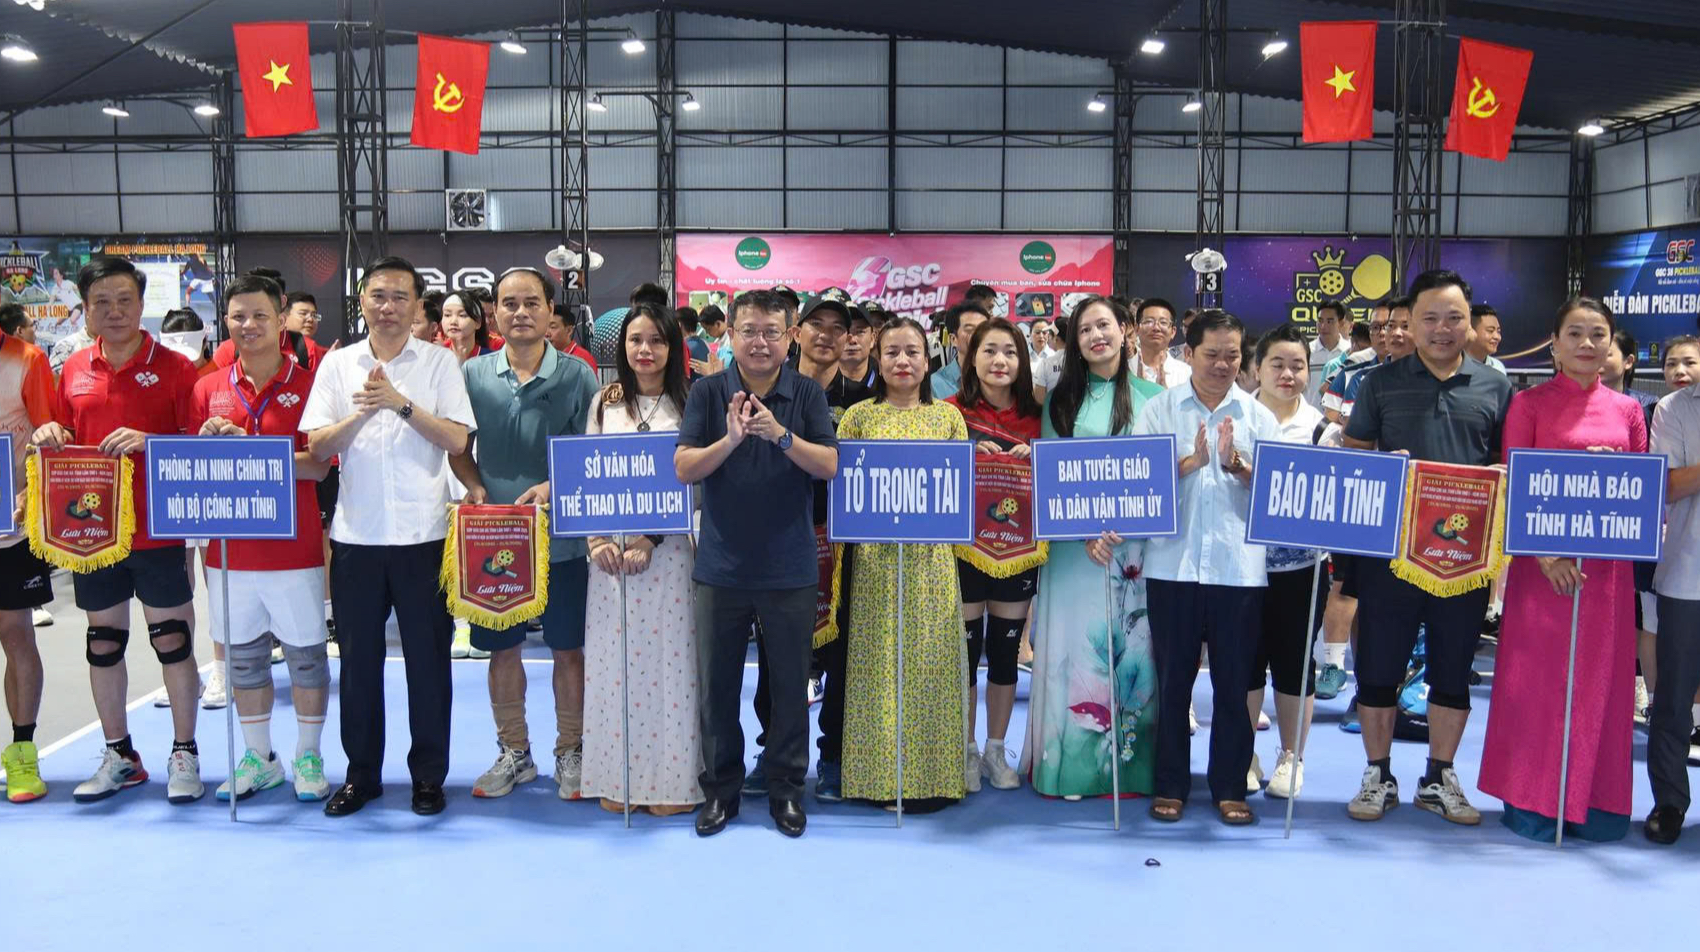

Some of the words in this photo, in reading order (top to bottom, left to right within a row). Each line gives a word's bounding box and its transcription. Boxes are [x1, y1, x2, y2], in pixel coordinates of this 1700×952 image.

[0, 256, 40, 273] ICKLEBALL
[886, 263, 940, 290] GSC
[568, 271, 579, 289] 2
[1206, 273, 1218, 291] 3
[1296, 288, 1322, 303] GSC
[1628, 292, 1649, 314] ĐÀN
[49, 305, 69, 318] LONG
[158, 453, 192, 481] PHÒNG
[194, 459, 208, 481] AN
[210, 459, 234, 481] NINH
[236, 455, 266, 481] CHÍNH
[267, 459, 284, 486] TRỊ
[585, 449, 601, 479] SỞ
[604, 451, 628, 478] VĂN
[630, 450, 656, 477] HÓA
[1058, 460, 1082, 483] BAN
[1084, 454, 1120, 482] TUYÊN
[1123, 453, 1150, 480] GIÁO
[843, 448, 866, 514] TỔ
[869, 467, 928, 524] TRỌNG
[932, 458, 960, 514] TÀI
[1267, 461, 1308, 520] BÁO
[1309, 465, 1337, 523] HÀ
[1341, 468, 1387, 527] TĨNH
[1528, 469, 1558, 501] HỘI
[1563, 470, 1600, 498] NHÀ
[1605, 471, 1643, 500] BÁO
[167, 492, 185, 524] NỘI
[187, 492, 200, 524] BỘ
[202, 492, 232, 521] (CÔNG
[235, 497, 249, 519] AN
[251, 489, 277, 521] TỈNH)
[560, 486, 582, 517] THỂ
[585, 494, 615, 516] THAO
[617, 488, 634, 515] VÀ
[636, 492, 653, 515] DU
[656, 491, 683, 518] LỊCH
[1048, 494, 1064, 520] VÀ
[1066, 493, 1090, 520] DÂN
[1092, 492, 1116, 524] VẬN
[1118, 488, 1145, 518] TỈNH
[1147, 488, 1162, 517] ỦY
[1526, 505, 1566, 536] TỈNH
[1571, 510, 1595, 538] HÀ
[1601, 511, 1641, 540] TĨNH
